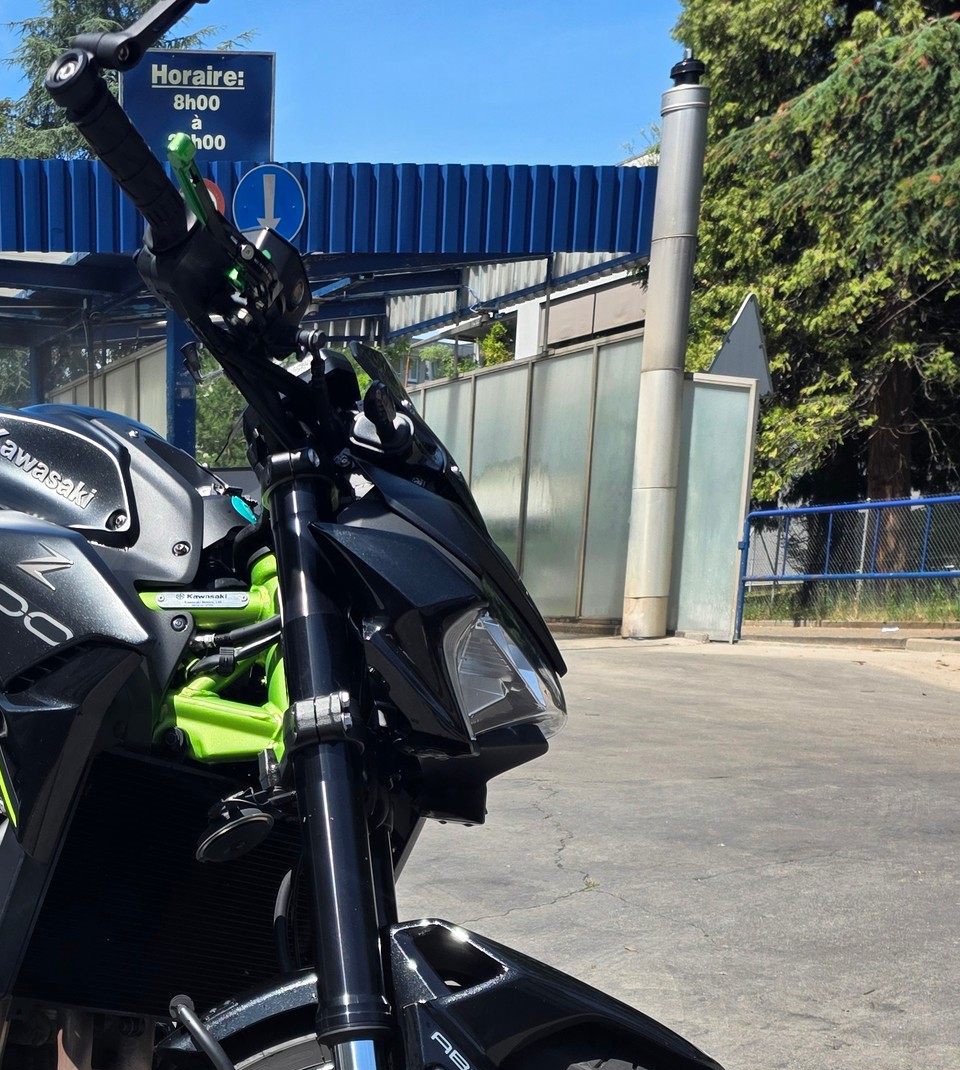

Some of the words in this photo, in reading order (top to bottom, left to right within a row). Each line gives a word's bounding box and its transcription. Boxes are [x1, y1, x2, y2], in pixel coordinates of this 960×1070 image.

[151, 64, 244, 87] Horaire:
[173, 93, 221, 111] 8h00
[191, 114, 202, 130] à
[168, 133, 226, 151] h00
